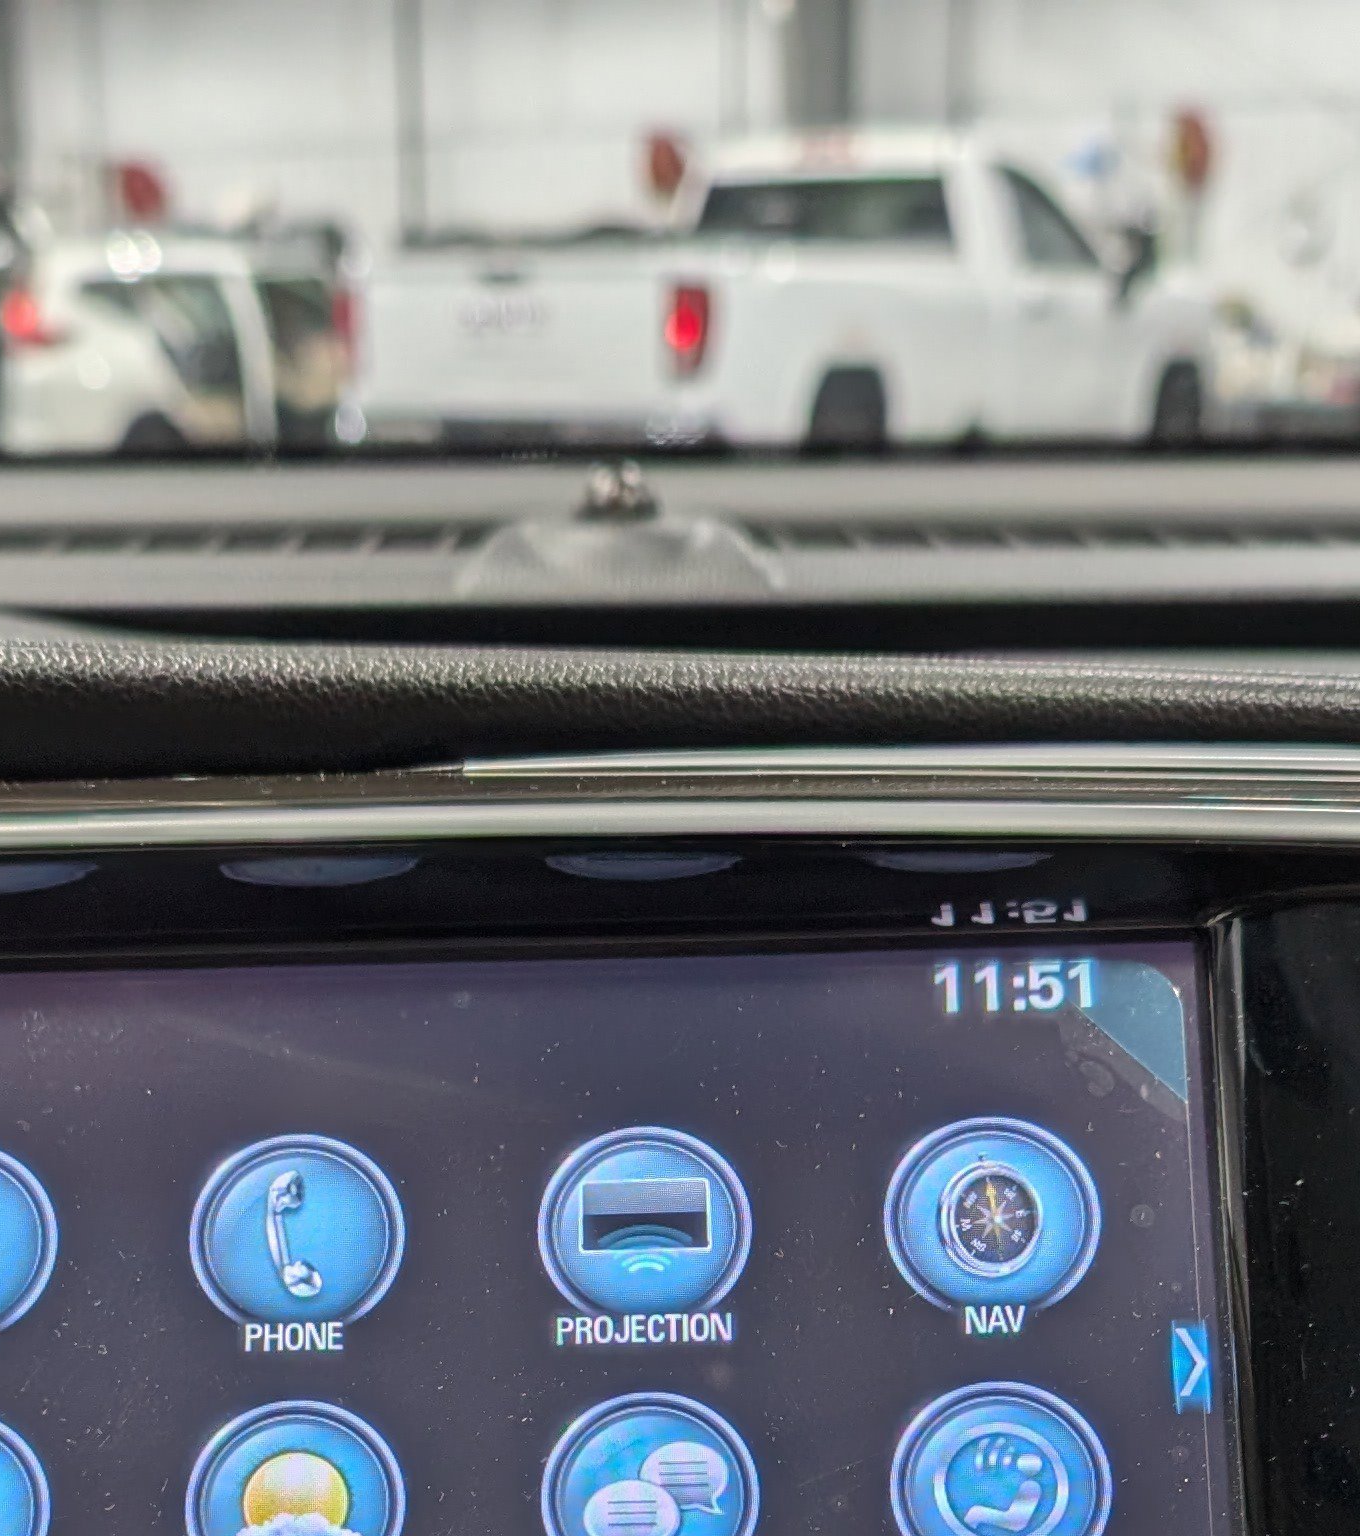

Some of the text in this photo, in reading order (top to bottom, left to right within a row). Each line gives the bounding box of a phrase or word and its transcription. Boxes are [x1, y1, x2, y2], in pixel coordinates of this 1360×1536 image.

[934, 961, 1094, 1013] 11:51
[556, 1312, 733, 1346] PROJECTION
[964, 1305, 1026, 1335] NAV
[243, 1321, 344, 1352] PHONE
